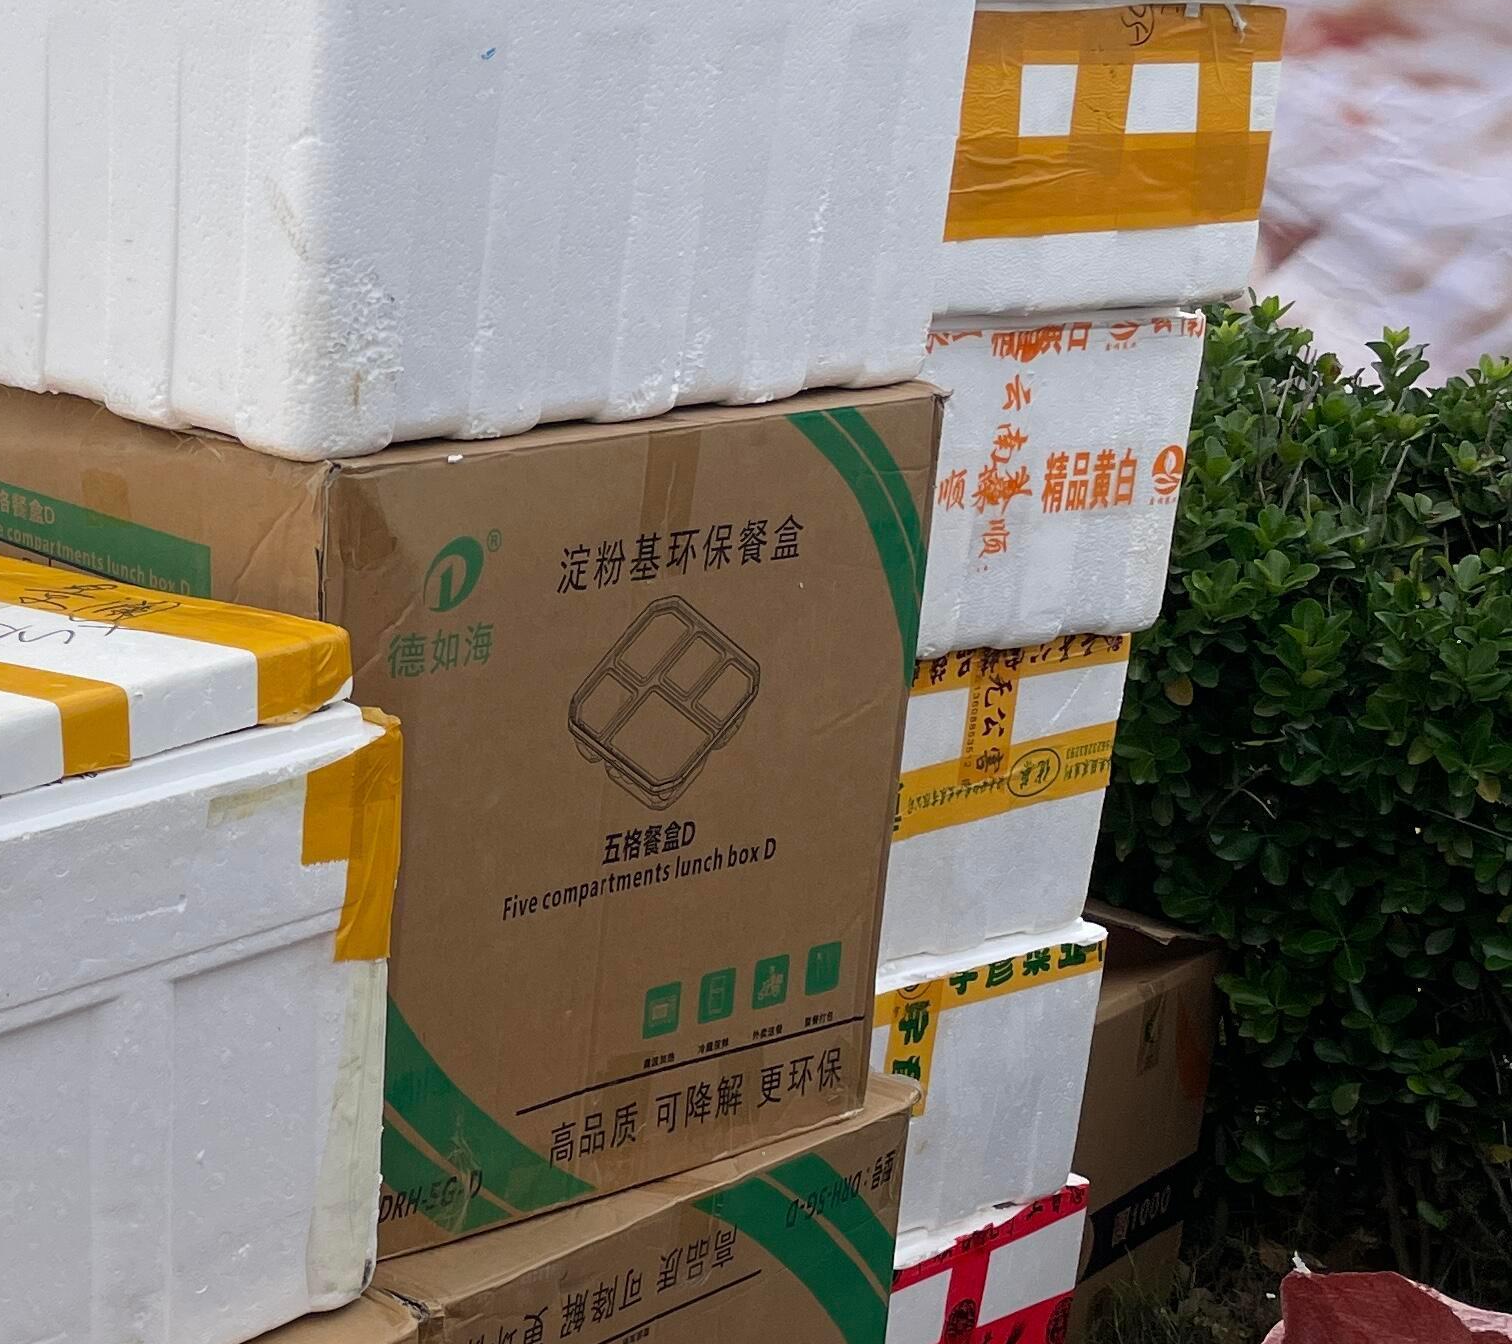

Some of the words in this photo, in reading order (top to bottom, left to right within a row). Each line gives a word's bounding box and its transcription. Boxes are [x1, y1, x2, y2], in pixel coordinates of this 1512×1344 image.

[6, 527, 104, 573] compartments
[106, 553, 146, 587] lunch
[148, 570, 176, 594] box
[557, 514, 804, 594] 淀粉基环保餐盒
[388, 621, 494, 680] 德如海
[601, 820, 696, 866] 五格餐盒D
[502, 895, 538, 922] Five
[542, 863, 670, 913] compartments
[674, 853, 723, 885] lunch
[727, 842, 758, 871] box
[763, 836, 778, 861] D
[549, 1102, 638, 1168] 高品质
[655, 1069, 744, 1136] 可降解
[756, 1046, 843, 1108] 更环保
[658, 1223, 738, 1294] 高品质
[560, 1268, 643, 1340] 可降解
